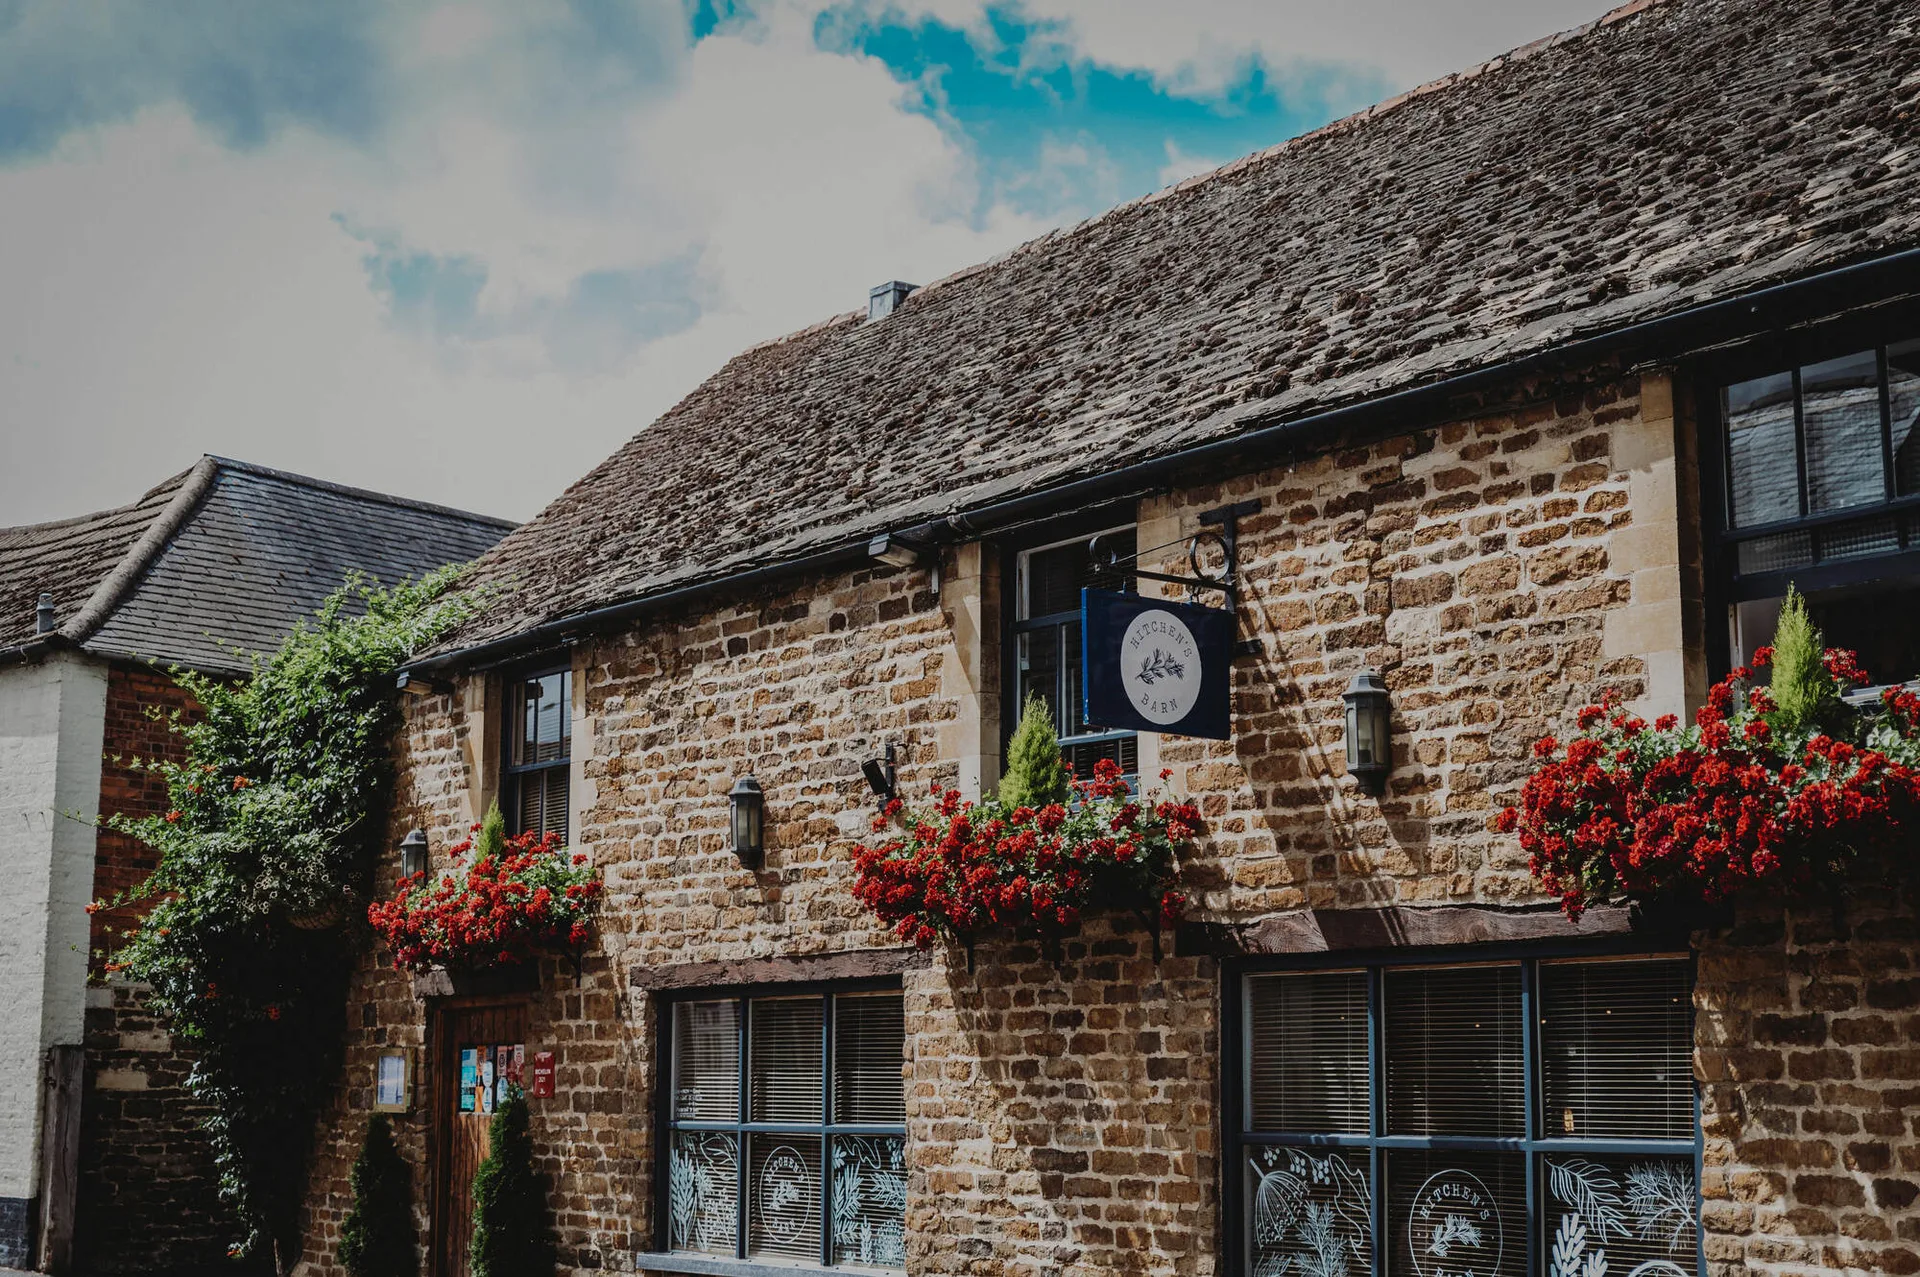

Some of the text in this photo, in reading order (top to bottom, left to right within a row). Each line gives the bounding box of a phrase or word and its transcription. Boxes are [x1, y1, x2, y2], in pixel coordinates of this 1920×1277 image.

[1130, 621, 1192, 658] HITCHEN'S
[1141, 693, 1178, 713] BARN
[1420, 1184, 1490, 1220] HITCHEN'S
